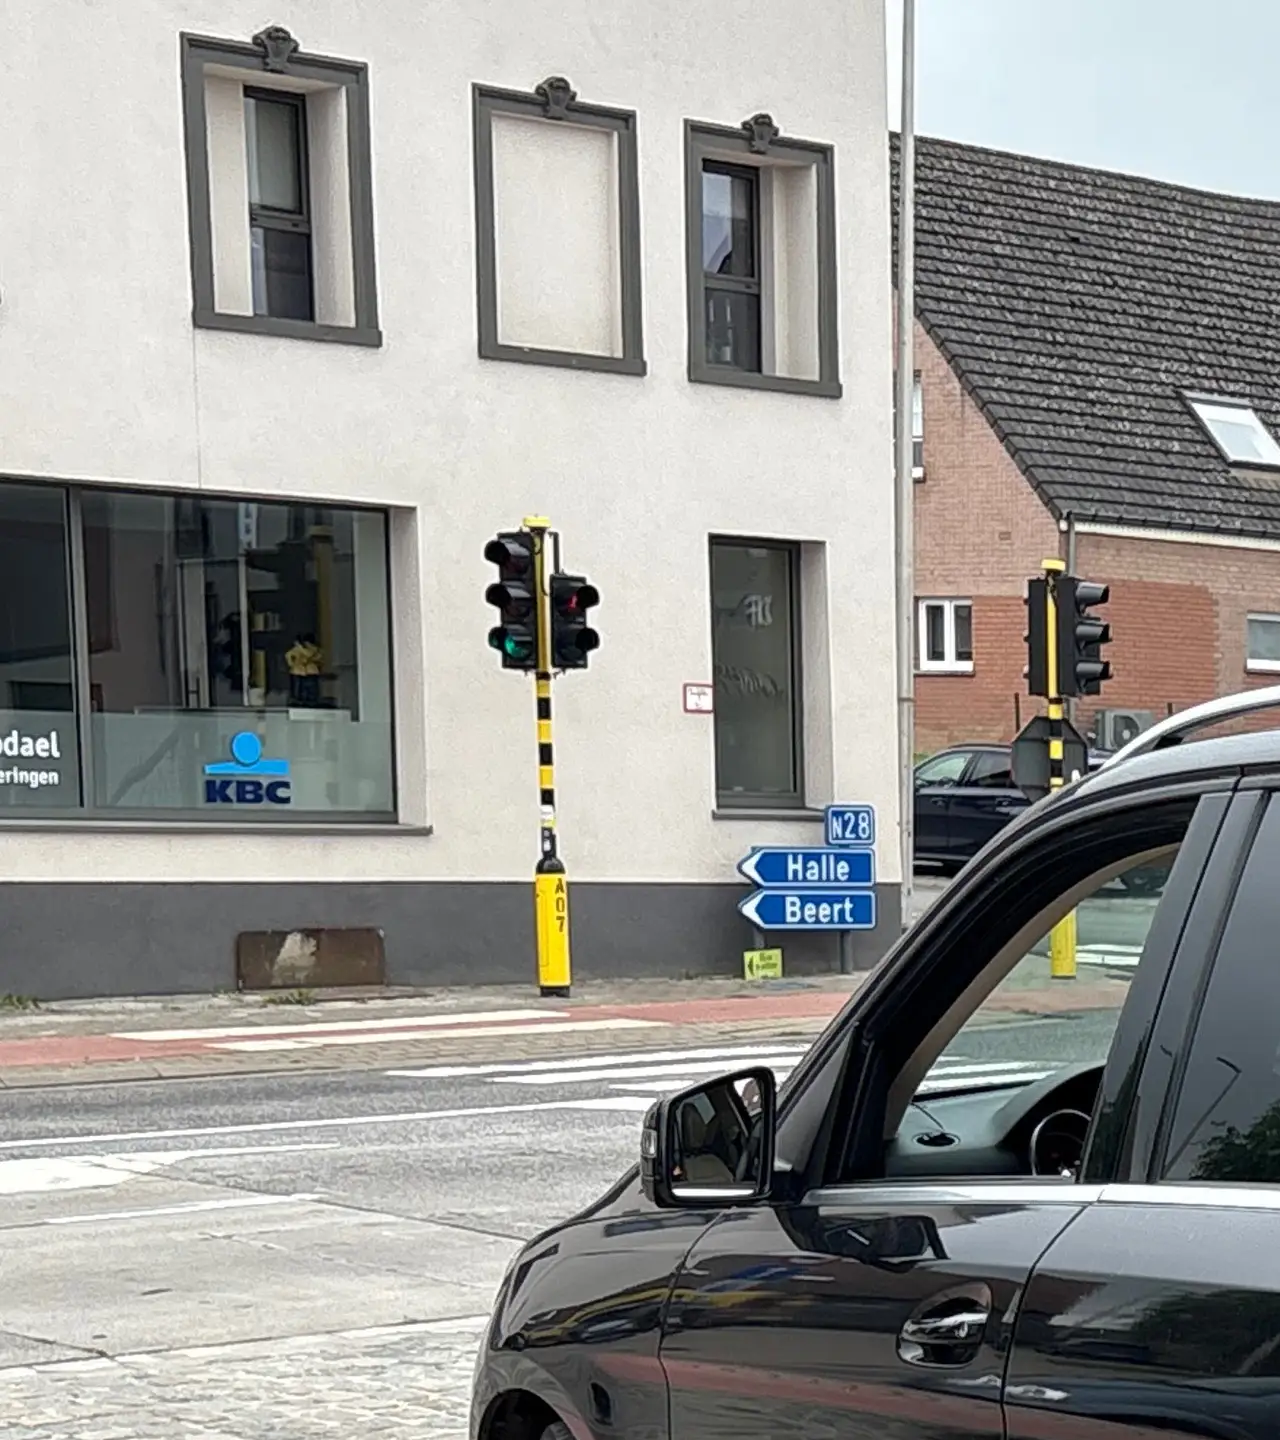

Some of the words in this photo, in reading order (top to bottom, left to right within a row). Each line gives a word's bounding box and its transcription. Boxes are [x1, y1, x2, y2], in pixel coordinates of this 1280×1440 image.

[0, 730, 60, 757] dael
[204, 780, 291, 804] KBC
[831, 812, 870, 839] N28
[787, 854, 850, 881] Halle
[785, 896, 854, 923] Beert
